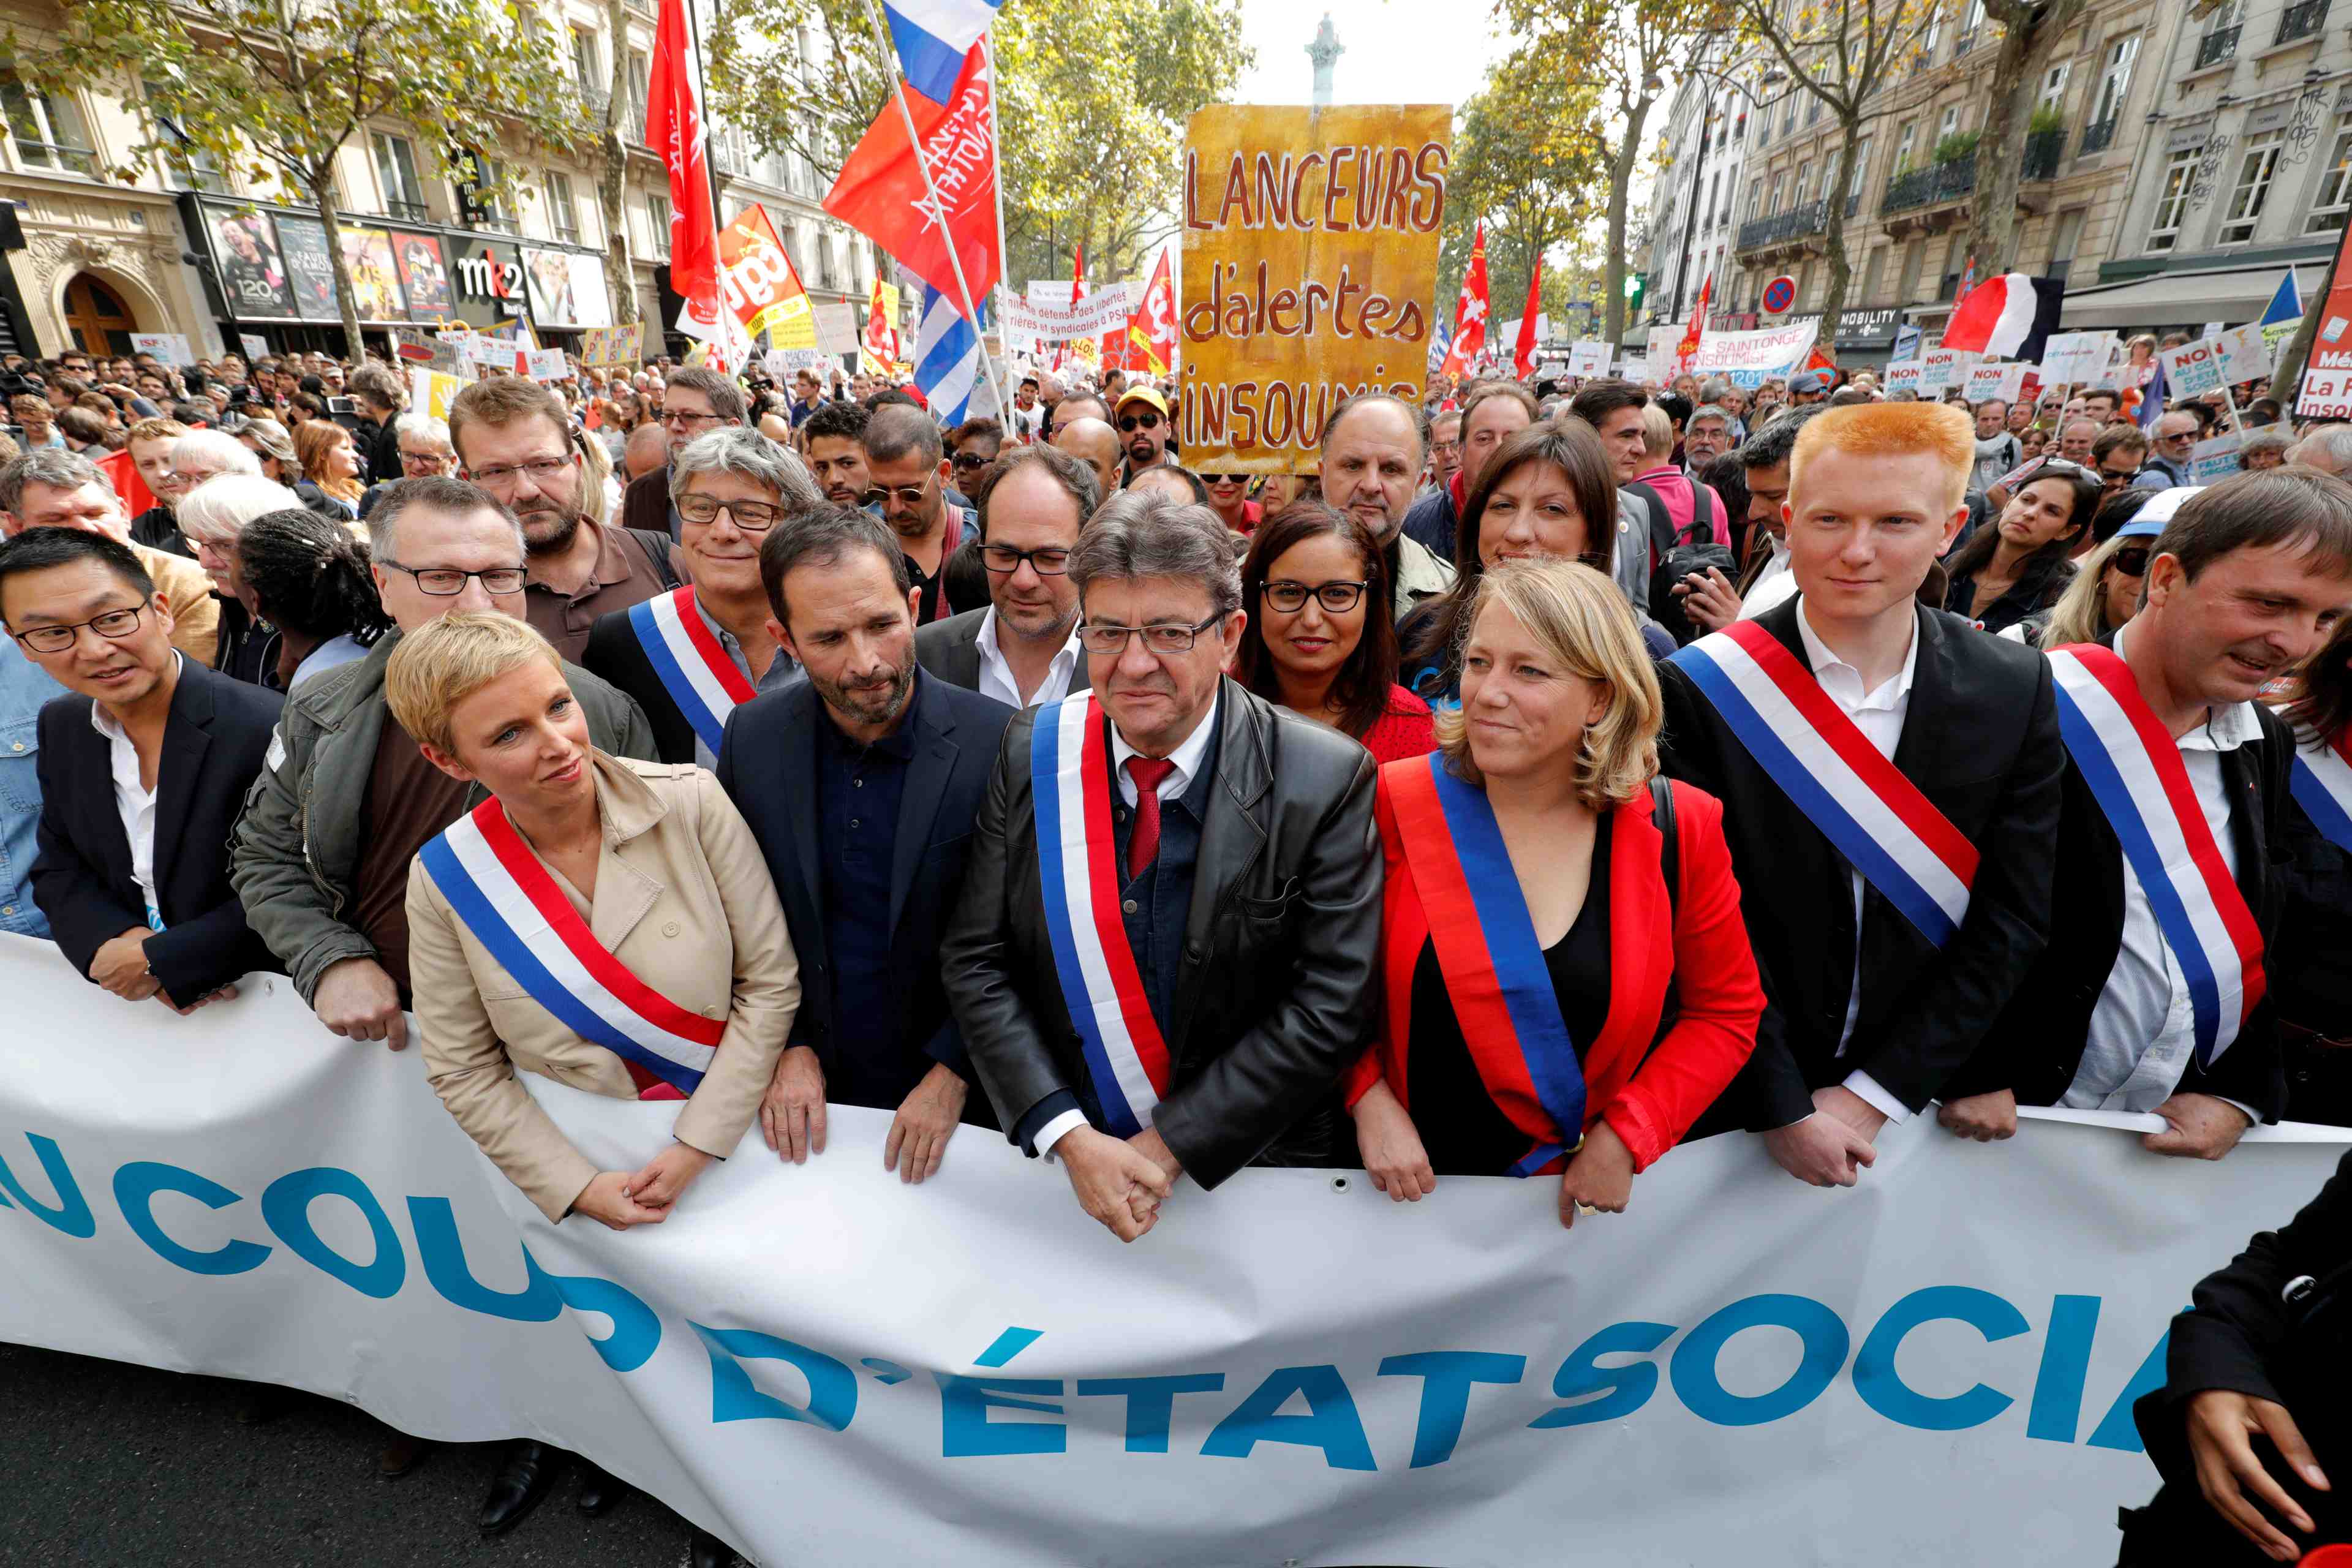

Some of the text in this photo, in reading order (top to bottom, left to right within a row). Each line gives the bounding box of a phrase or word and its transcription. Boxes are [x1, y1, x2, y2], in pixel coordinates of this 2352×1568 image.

[1185, 141, 1449, 234] LANCEURS
[458, 247, 525, 300] mk2
[236, 278, 273, 298] 120
[1183, 260, 1426, 342] d'alertes
[997, 312, 1038, 330] ourières
[1050, 318, 1098, 336] syndicales
[1841, 309, 1896, 326] MOBILITY
[1717, 328, 1804, 354] SAINTONGE
[1695, 351, 1768, 368] NSOUMISE
[1926, 354, 1953, 365] NON
[1891, 369, 1919, 379] NON
[1973, 369, 2002, 379] NON
[2305, 375, 2334, 397] La
[1185, 363, 1417, 449] iNSOU
[0, 1131, 96, 1238] U
[685, 1317, 1527, 1471] D'ÉTAT
[1526, 1285, 2195, 1453] SOCI
